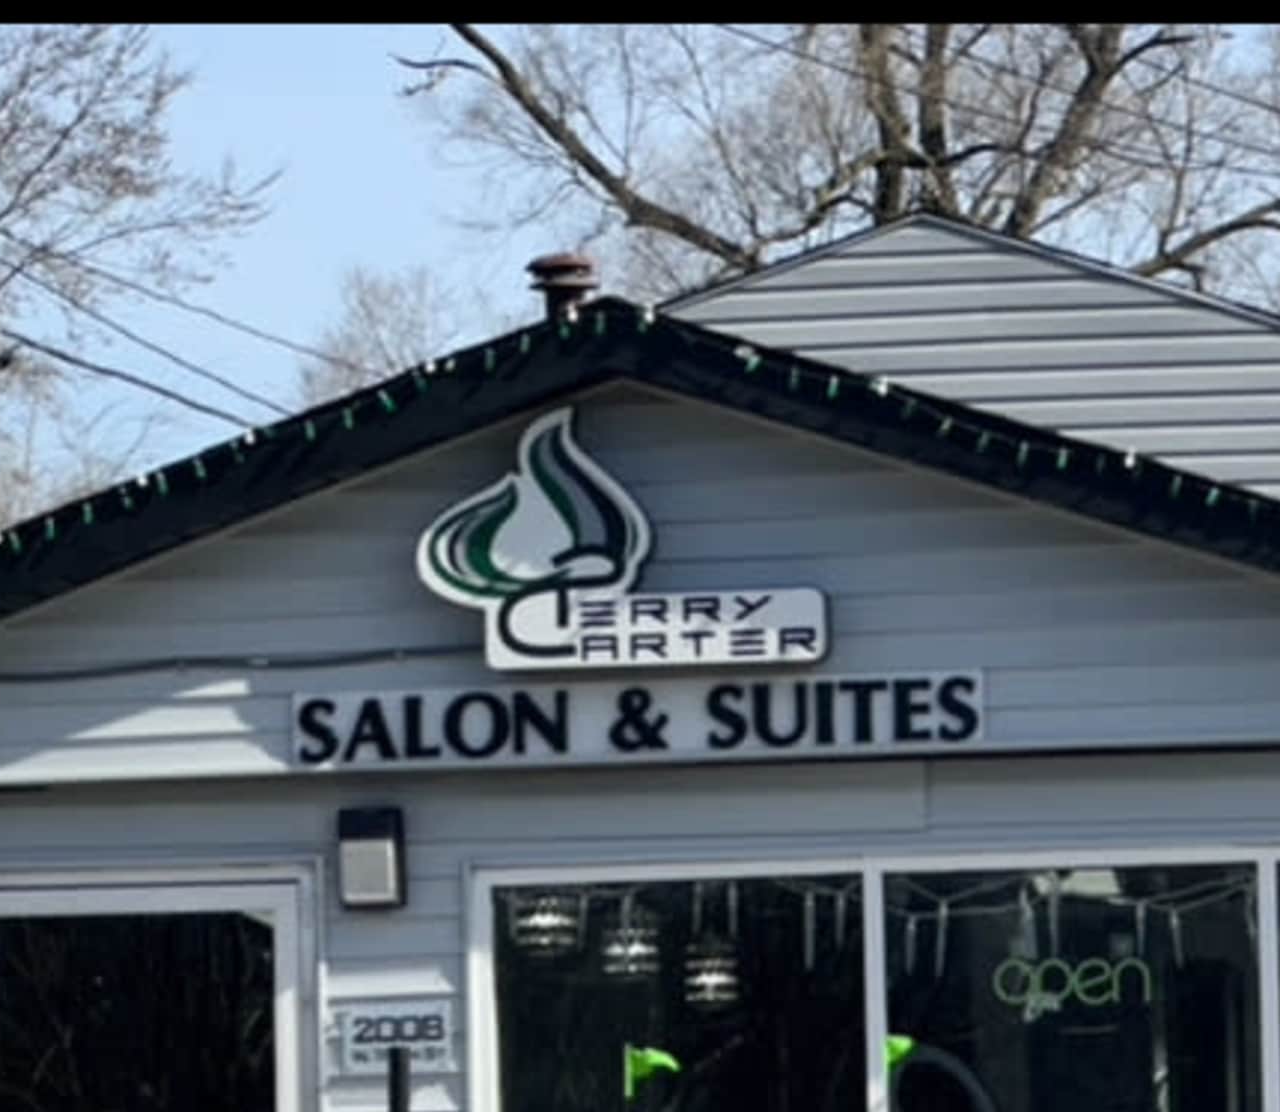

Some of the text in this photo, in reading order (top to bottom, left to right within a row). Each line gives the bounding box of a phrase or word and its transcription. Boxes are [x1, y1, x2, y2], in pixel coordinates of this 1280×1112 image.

[498, 582, 818, 662] CARTER
[542, 572, 773, 629] TERRY
[297, 676, 980, 765] SALON & SUITES
[992, 957, 1152, 1022] open
[352, 1013, 445, 1043] 2008
